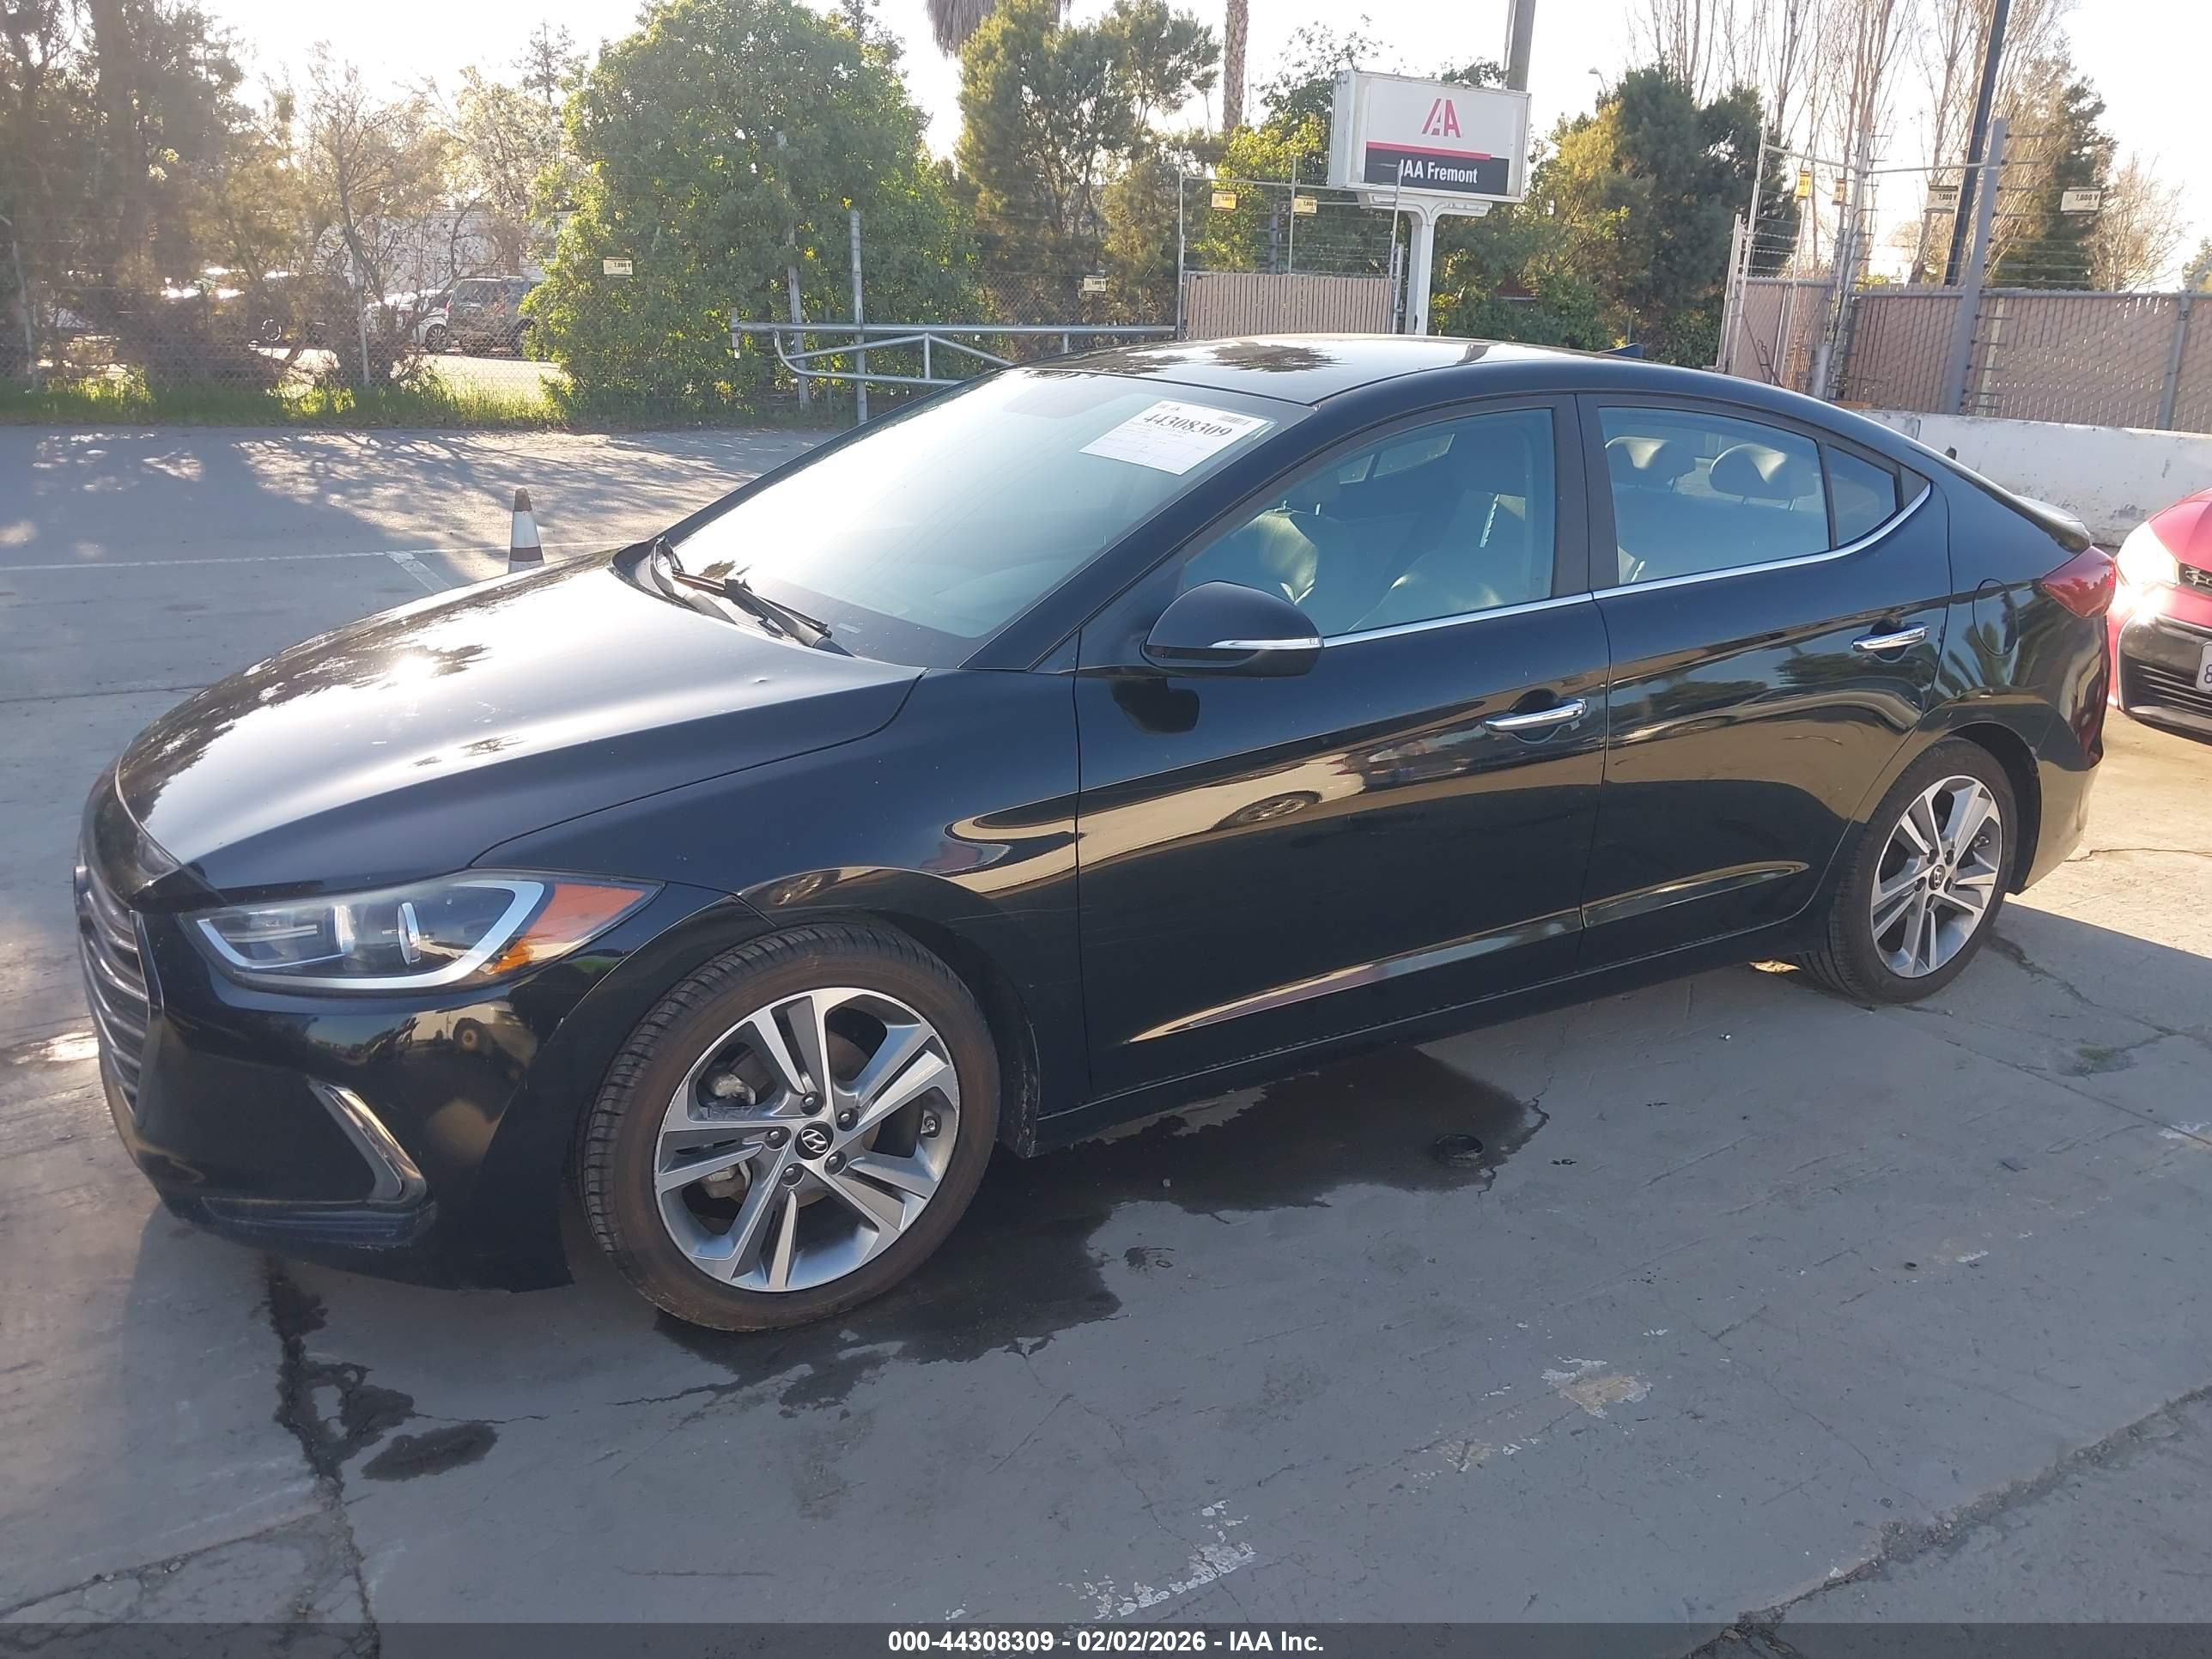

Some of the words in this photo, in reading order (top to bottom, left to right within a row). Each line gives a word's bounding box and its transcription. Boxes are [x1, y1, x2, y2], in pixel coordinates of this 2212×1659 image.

[1400, 158, 1424, 179] IAA
[1427, 161, 1478, 184] Fremont
[2075, 193, 2093, 202] 7,000
[1143, 413, 1233, 437] 44308309
